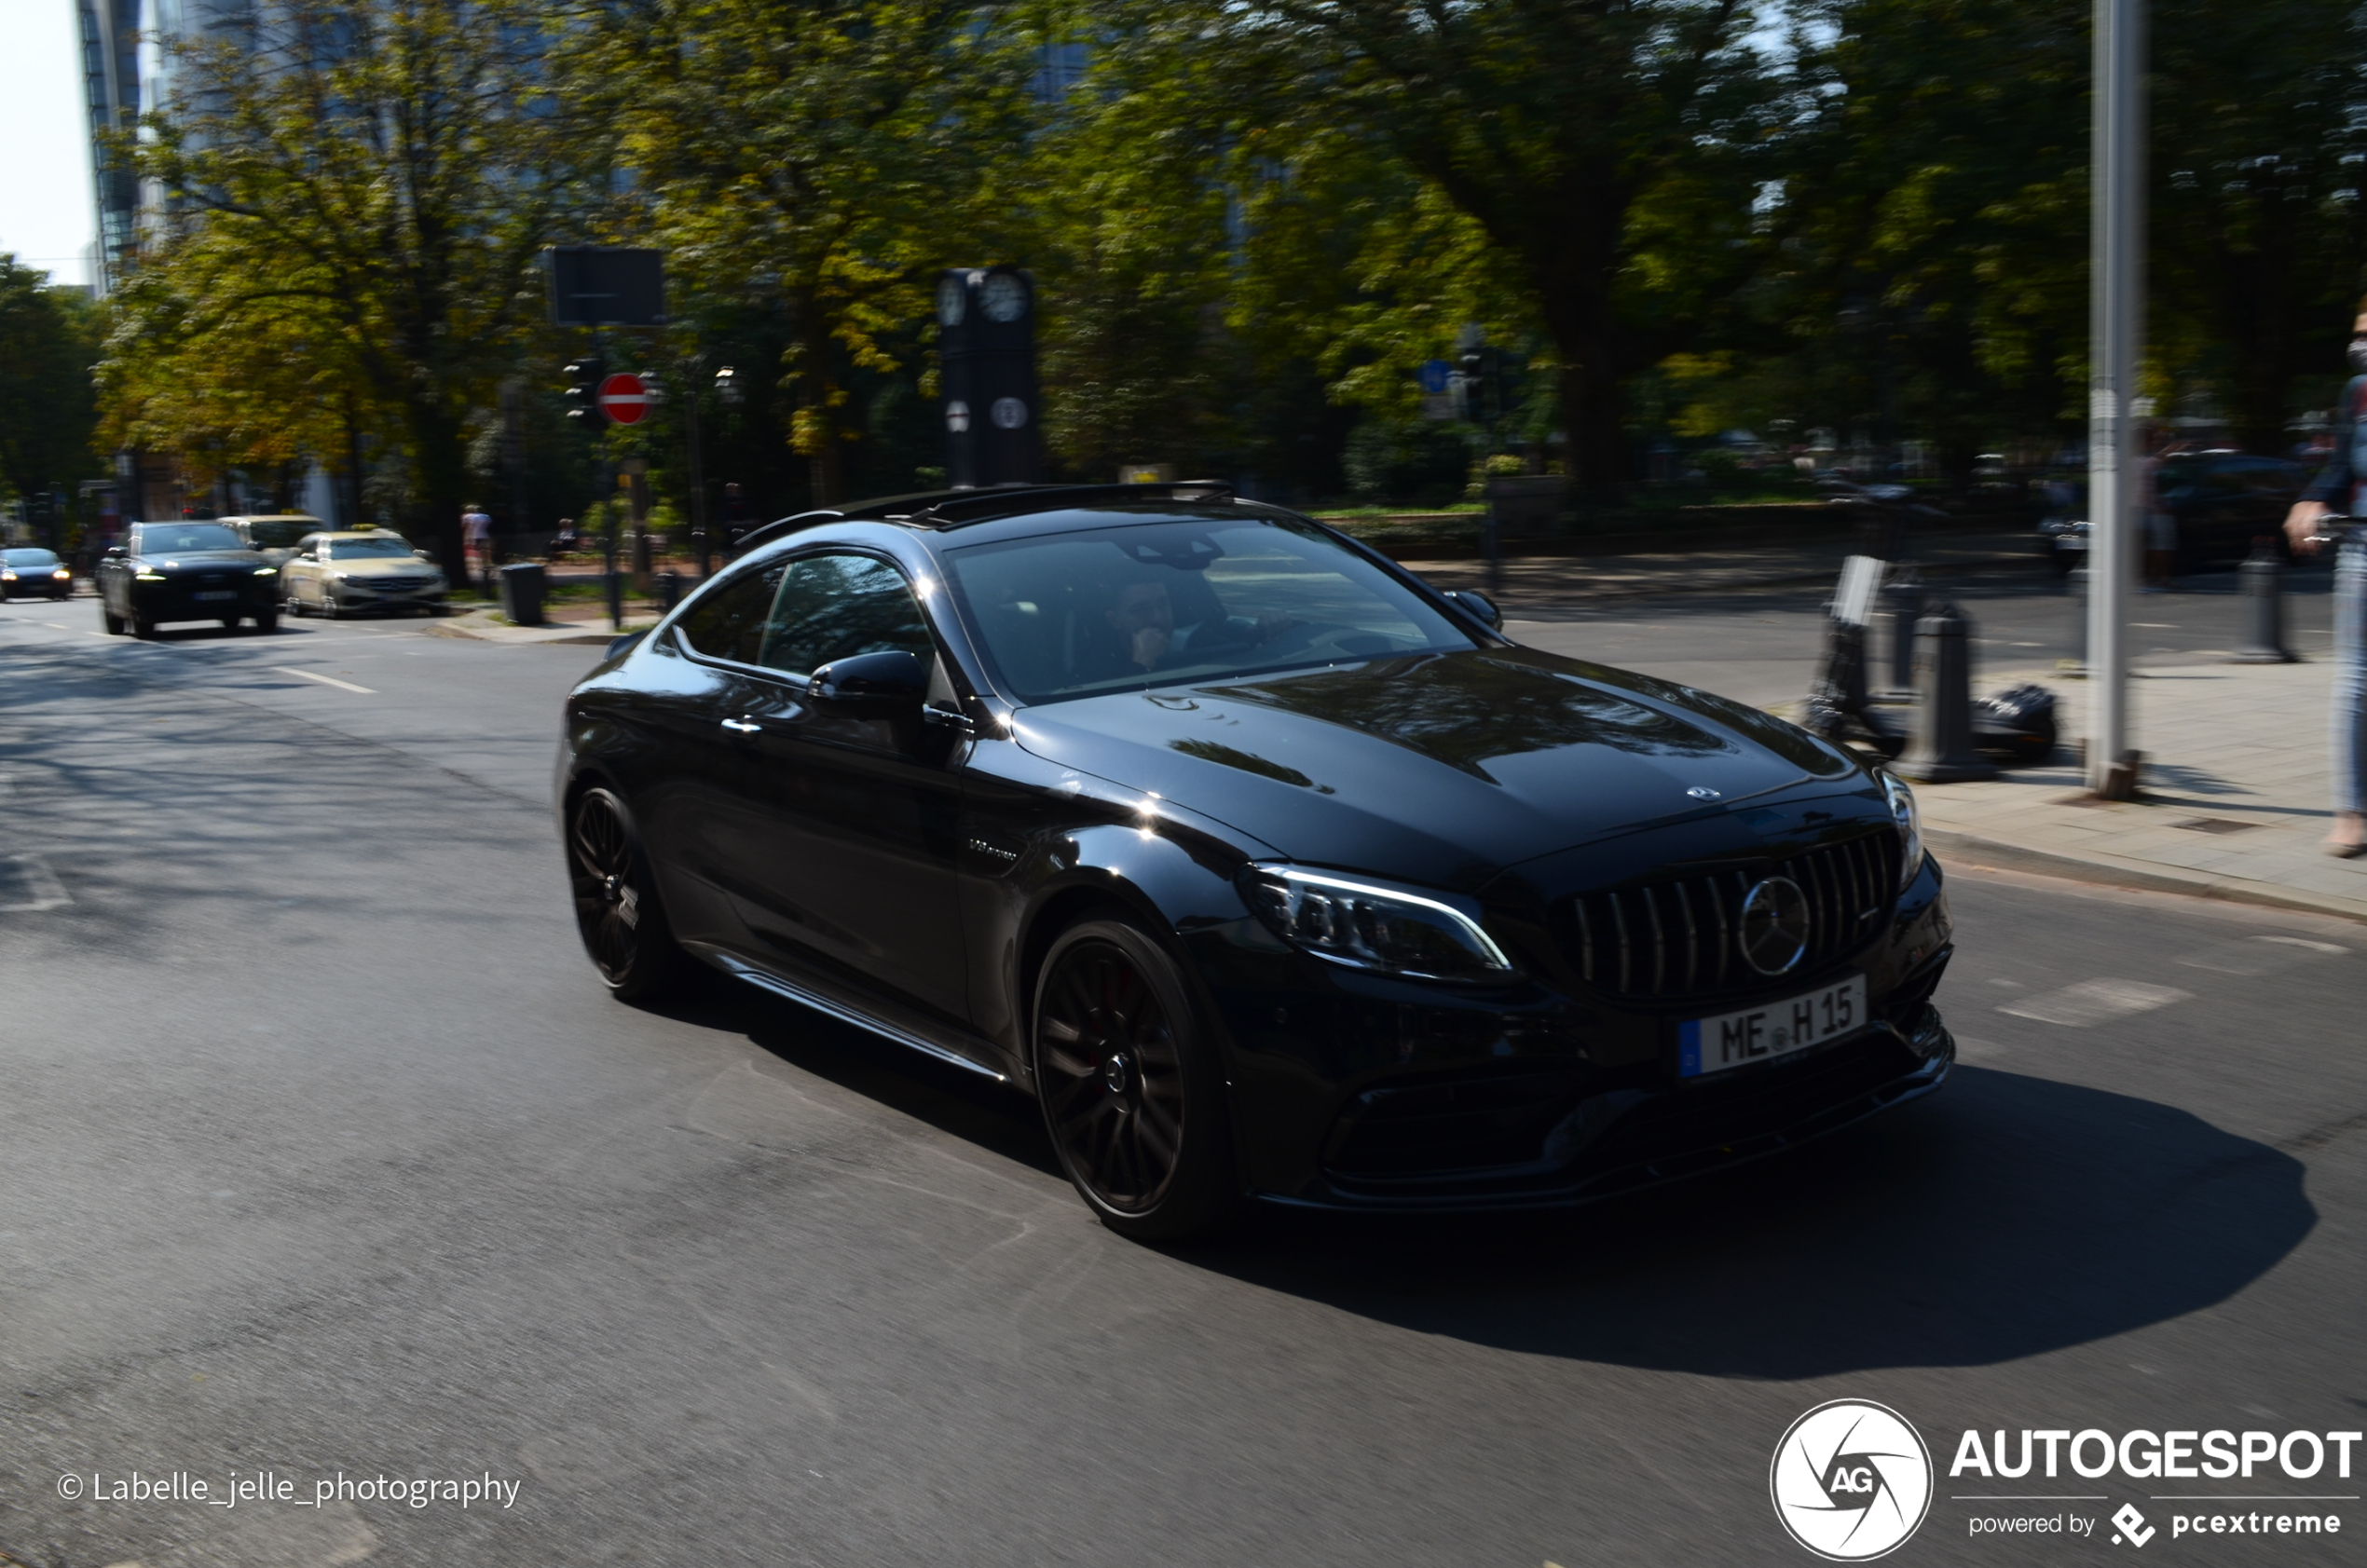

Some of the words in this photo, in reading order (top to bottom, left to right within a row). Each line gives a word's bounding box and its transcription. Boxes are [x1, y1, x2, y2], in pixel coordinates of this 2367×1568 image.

[1721, 1012, 1769, 1062] ME
[1793, 999, 1813, 1044] H
[1821, 985, 1853, 1035] 15
